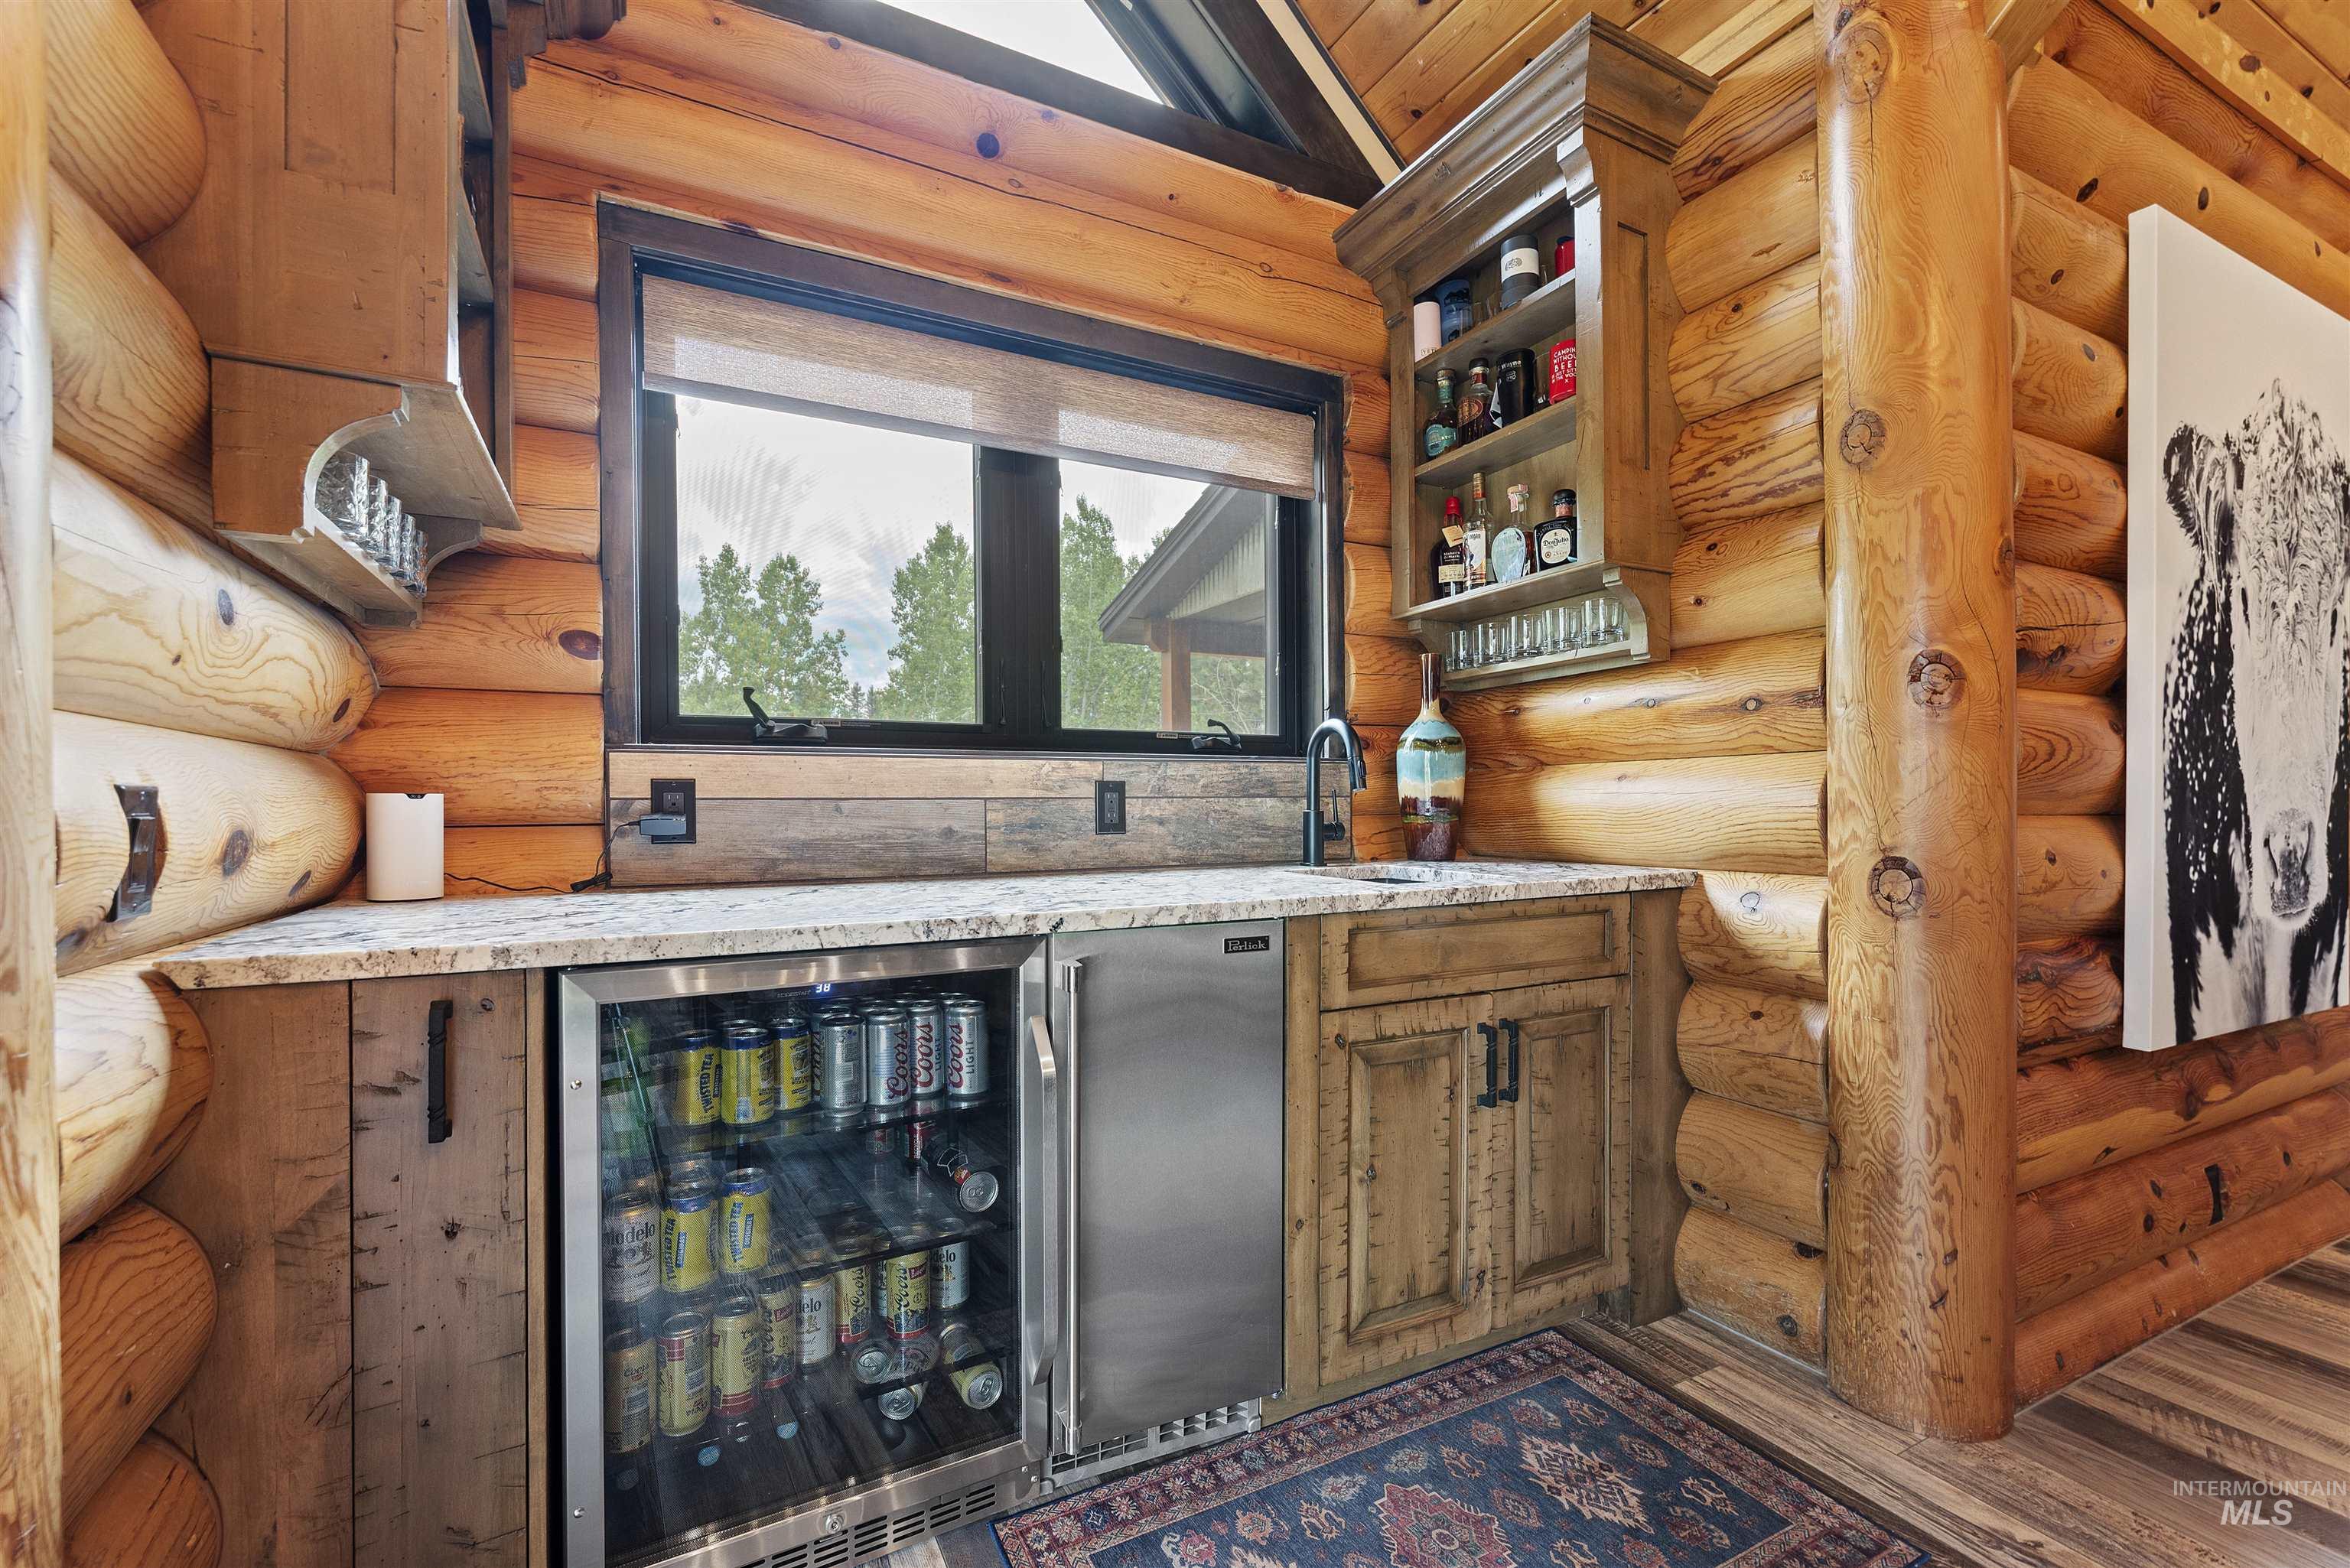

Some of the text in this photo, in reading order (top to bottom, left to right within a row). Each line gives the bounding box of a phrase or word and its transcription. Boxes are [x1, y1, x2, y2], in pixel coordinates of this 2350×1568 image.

[1554, 347, 1576, 358] CAMPIN
[1554, 353, 1577, 365] WITHOU
[1227, 940, 1267, 952] Perlick
[815, 983, 831, 994] 38
[887, 1030, 909, 1099] Coors
[910, 1022, 934, 1088] Coors
[948, 1023, 964, 1088] Coors
[965, 1041, 975, 1074] LIGHT
